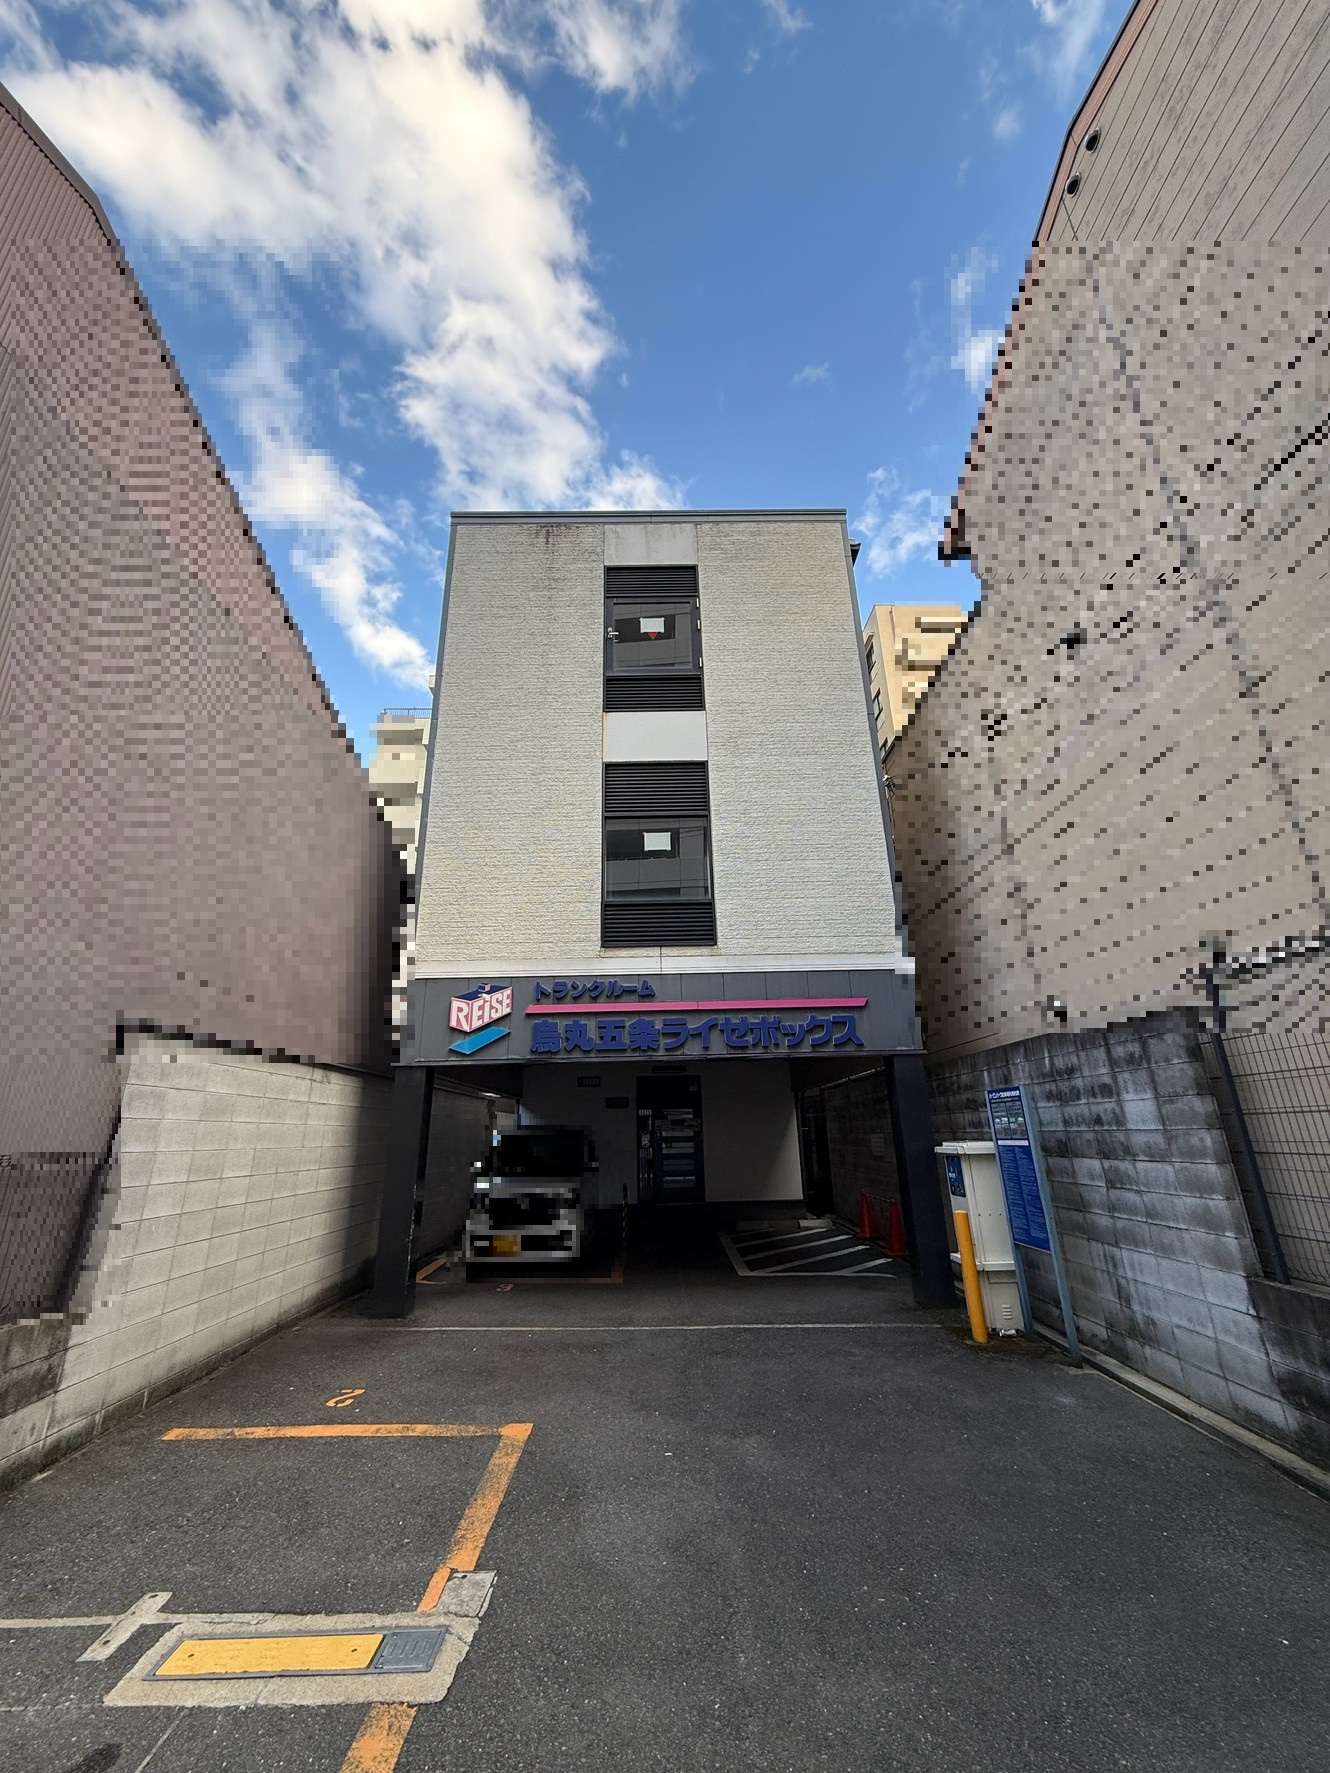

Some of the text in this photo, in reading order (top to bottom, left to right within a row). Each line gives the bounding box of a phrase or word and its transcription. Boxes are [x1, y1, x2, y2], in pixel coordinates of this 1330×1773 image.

[536, 979, 655, 998] トランクルーム
[532, 1014, 863, 1052] 烏丸五条ライゼボックス
